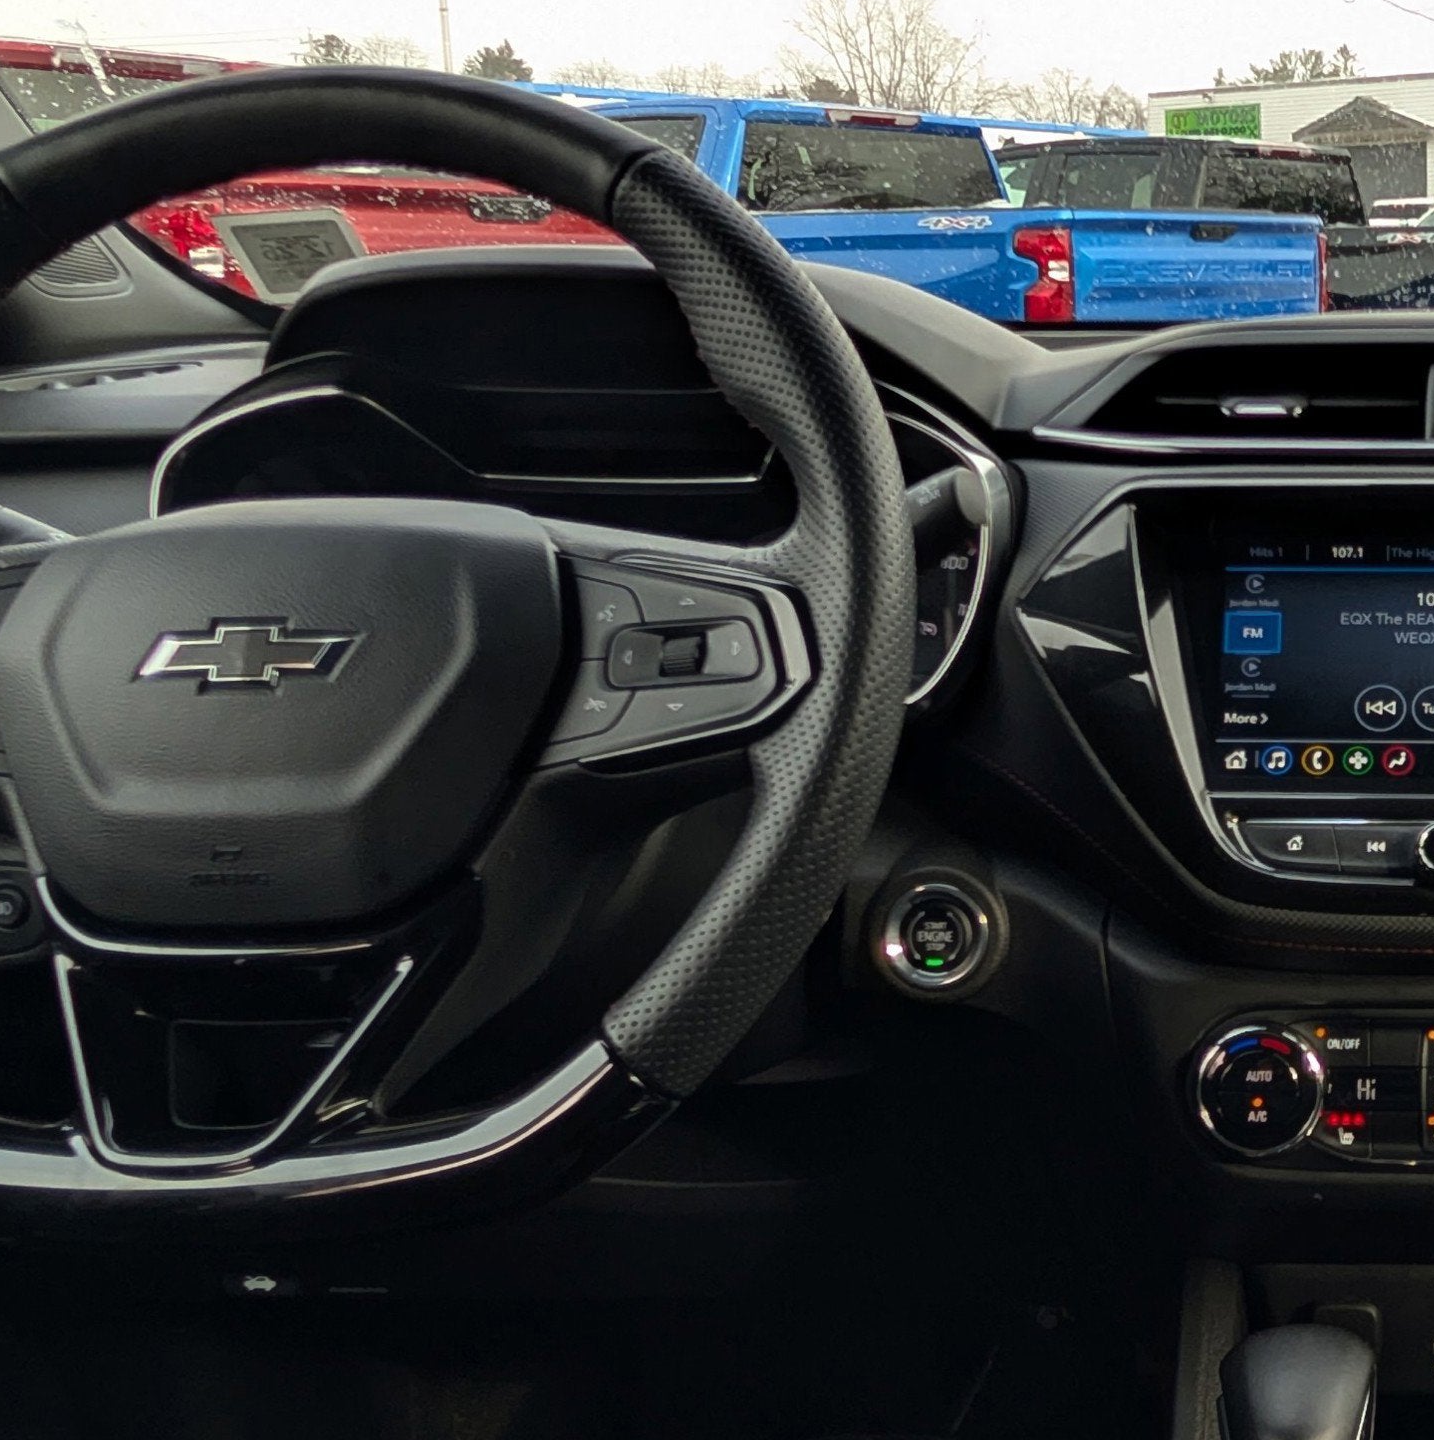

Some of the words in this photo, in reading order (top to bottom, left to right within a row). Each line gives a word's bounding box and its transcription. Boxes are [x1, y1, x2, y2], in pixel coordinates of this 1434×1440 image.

[1332, 546, 1364, 558] 107.1
[1391, 548, 1413, 558] The
[1340, 612, 1373, 627] EQX
[1375, 613, 1403, 626] The
[1243, 627, 1263, 639] FM
[1223, 712, 1258, 725] More
[916, 931, 954, 943] ENGINE
[1327, 1038, 1360, 1050] ON/OFF
[1246, 1070, 1273, 1082] AUTO
[1356, 1078, 1377, 1101] Hi
[1247, 1110, 1268, 1123] A/C
